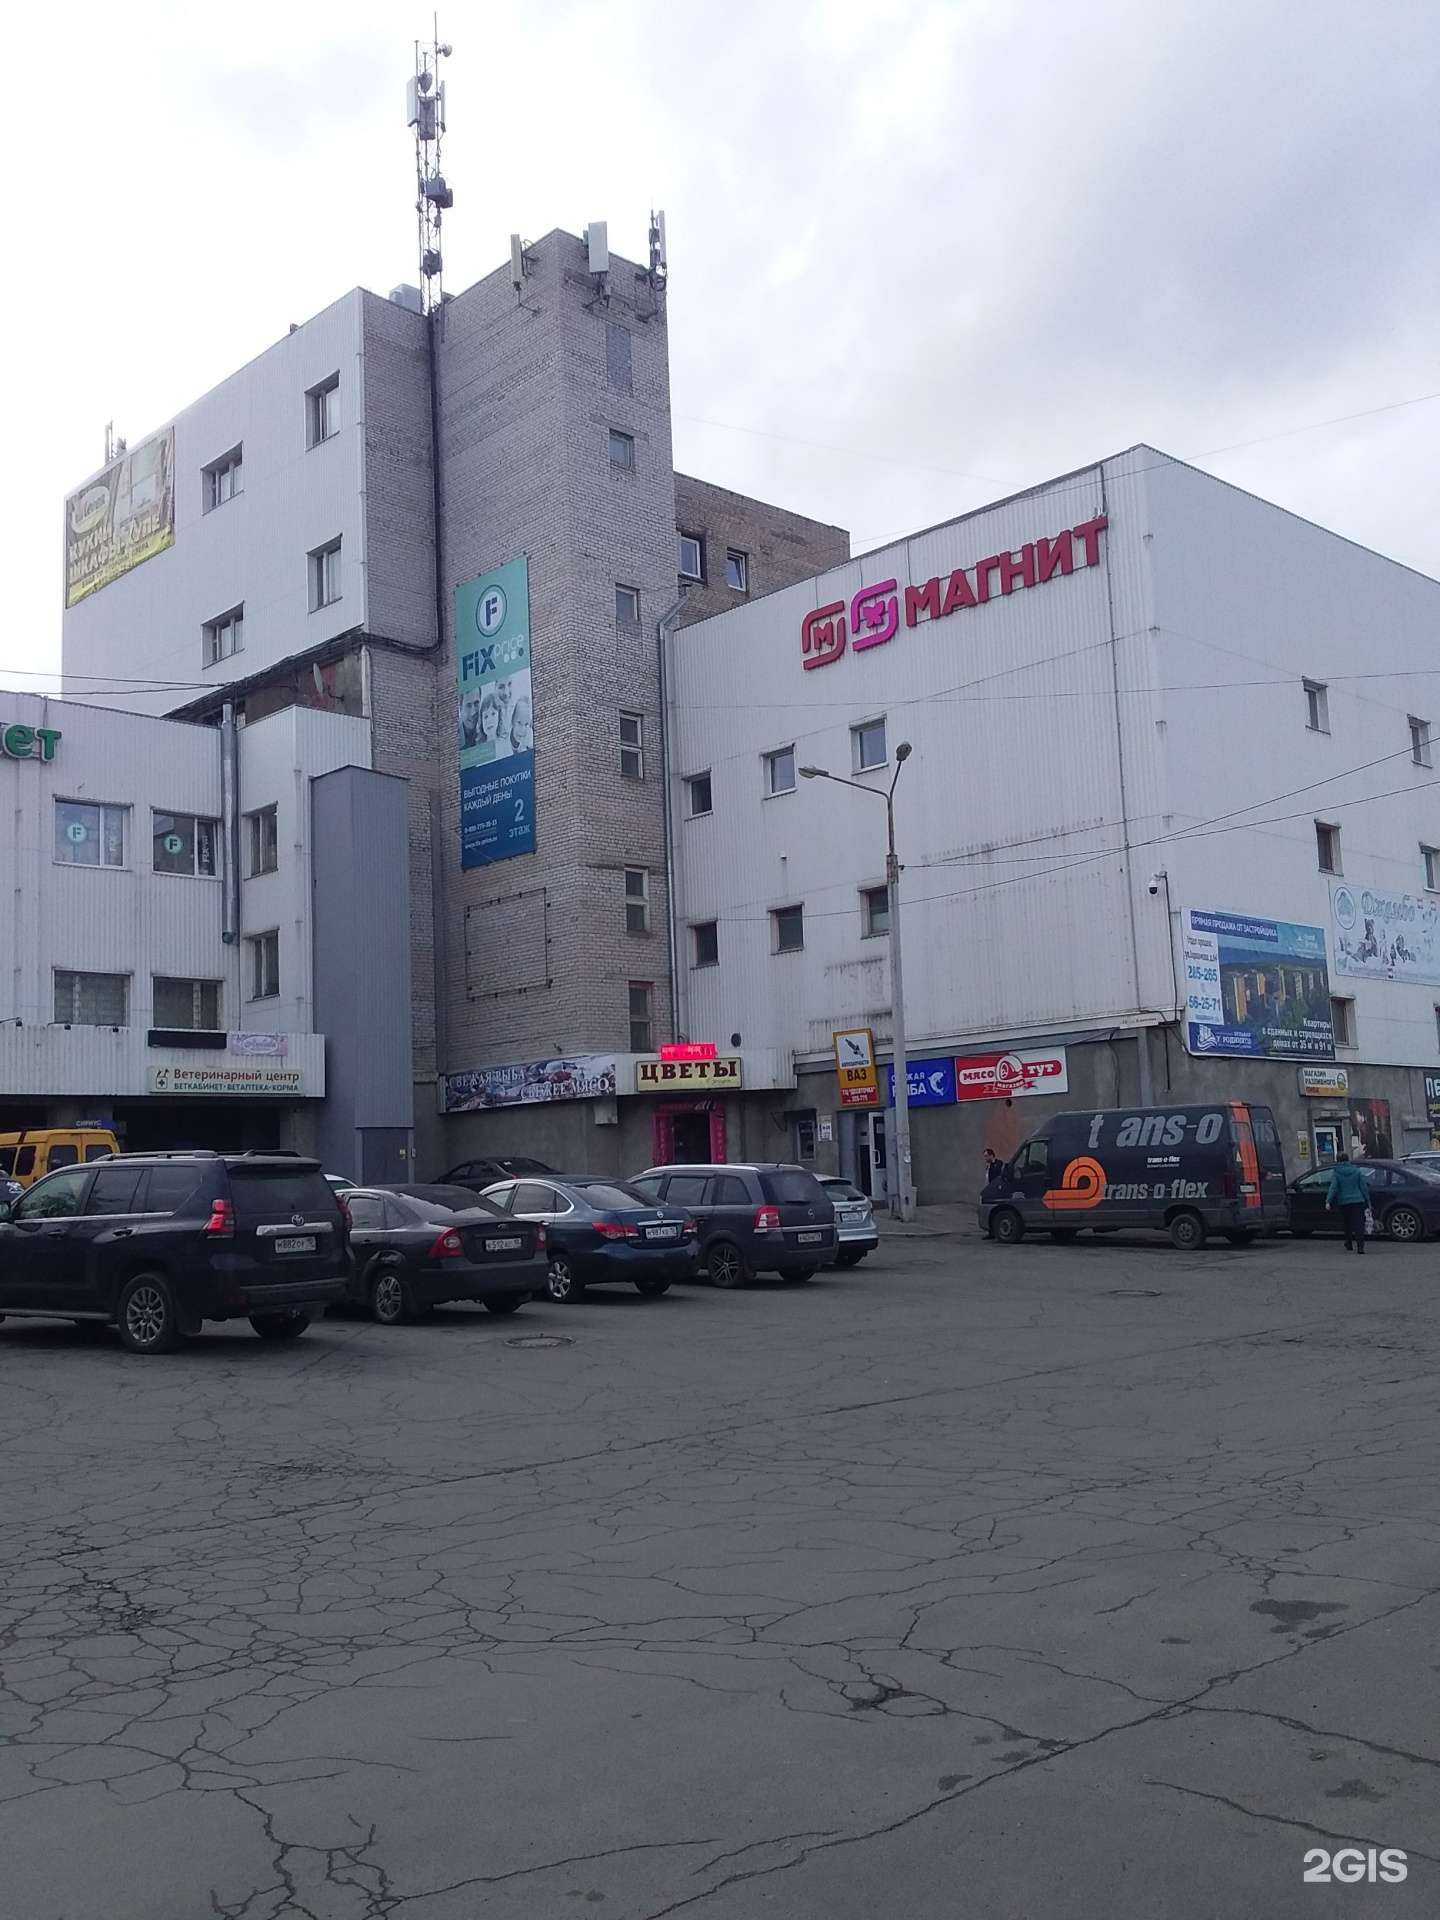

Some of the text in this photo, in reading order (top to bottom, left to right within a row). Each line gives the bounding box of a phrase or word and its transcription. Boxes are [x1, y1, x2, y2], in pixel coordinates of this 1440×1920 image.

[905, 515, 1108, 627] МАГНИТ
[485, 597, 498, 626] F
[463, 770, 531, 799] ВЫГОДНЫЕ ПОКУПКИ
[463, 793, 492, 812] КАЖДЫЙ
[514, 798, 524, 822] 2
[1212, 919, 1237, 931] ПРОДАЖА
[174, 1069, 299, 1083] Ветеринарный центр
[640, 1061, 738, 1083] ЦВЕТЫ
[847, 1069, 867, 1081] ВАЗ
[570, 1077, 610, 1094] МЯСО
[1103, 1180, 1209, 1200] trans-o-flex
